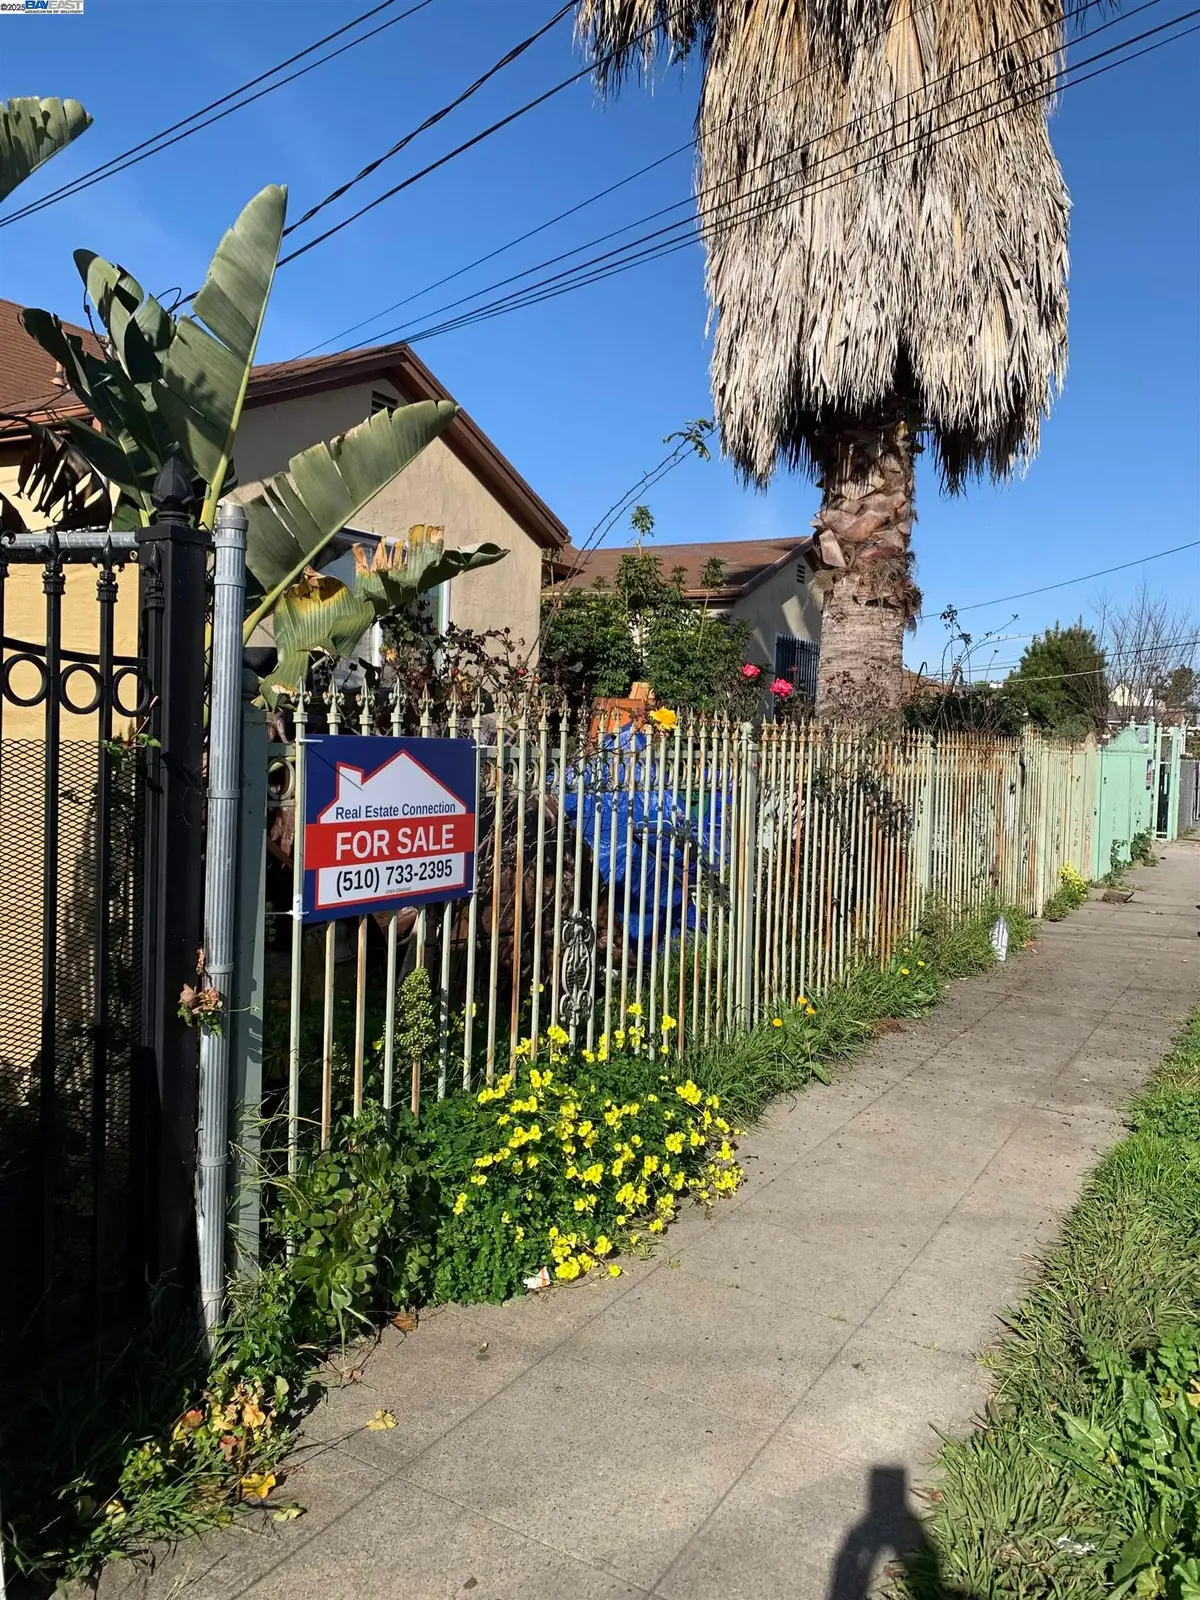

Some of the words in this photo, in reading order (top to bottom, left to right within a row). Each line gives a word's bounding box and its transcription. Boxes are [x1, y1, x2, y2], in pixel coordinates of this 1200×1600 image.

[335, 805, 362, 820] Real
[365, 805, 399, 819] Estate
[401, 801, 456, 816] Connection
[335, 829, 390, 861] FOR
[396, 823, 455, 854] SALE
[336, 867, 380, 898] (510)
[385, 859, 453, 886] 733-2395
